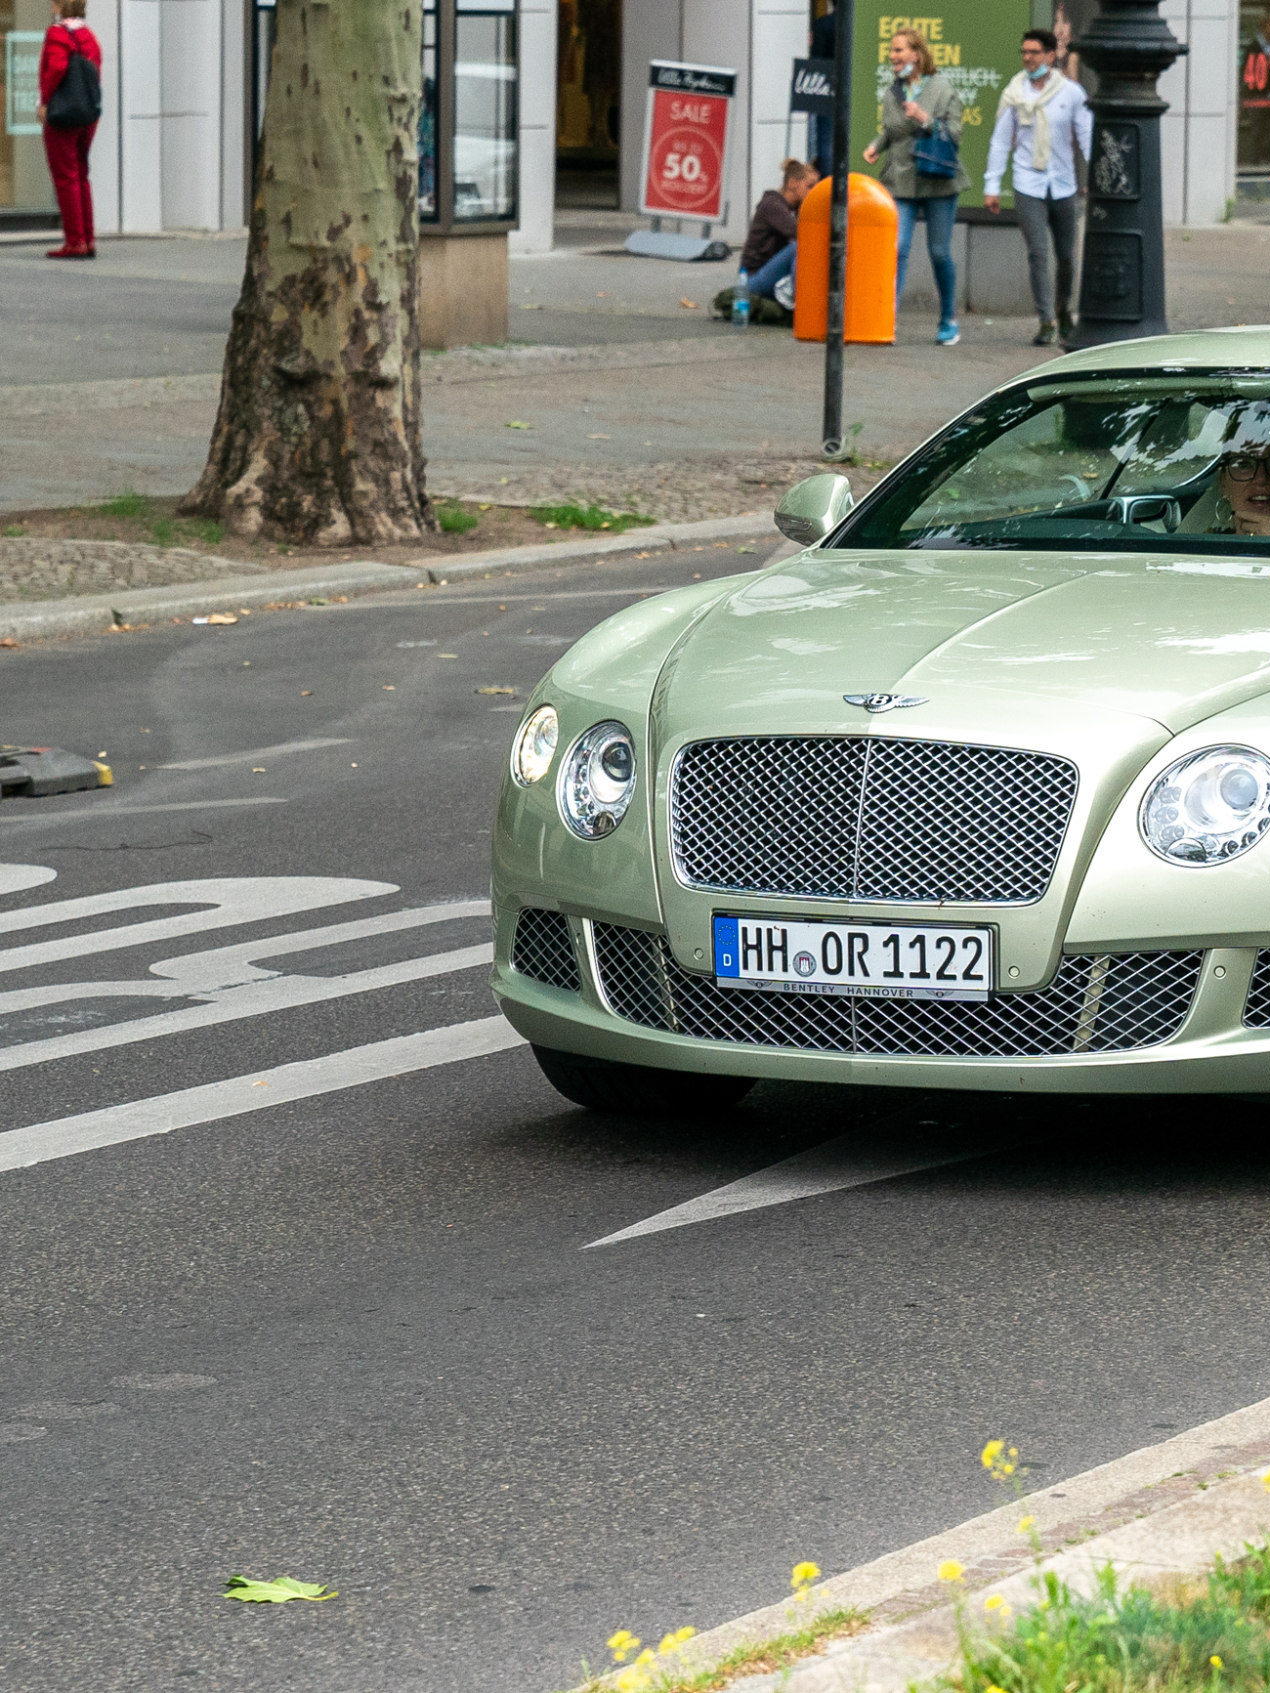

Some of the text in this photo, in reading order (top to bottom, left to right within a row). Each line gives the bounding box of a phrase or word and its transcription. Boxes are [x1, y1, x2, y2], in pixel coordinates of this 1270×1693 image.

[669, 101, 711, 124] SALE
[723, 953, 732, 967] D
[741, 926, 984, 981] HH OR 1122
[783, 983, 914, 998] BENTLEY HANNOVER
